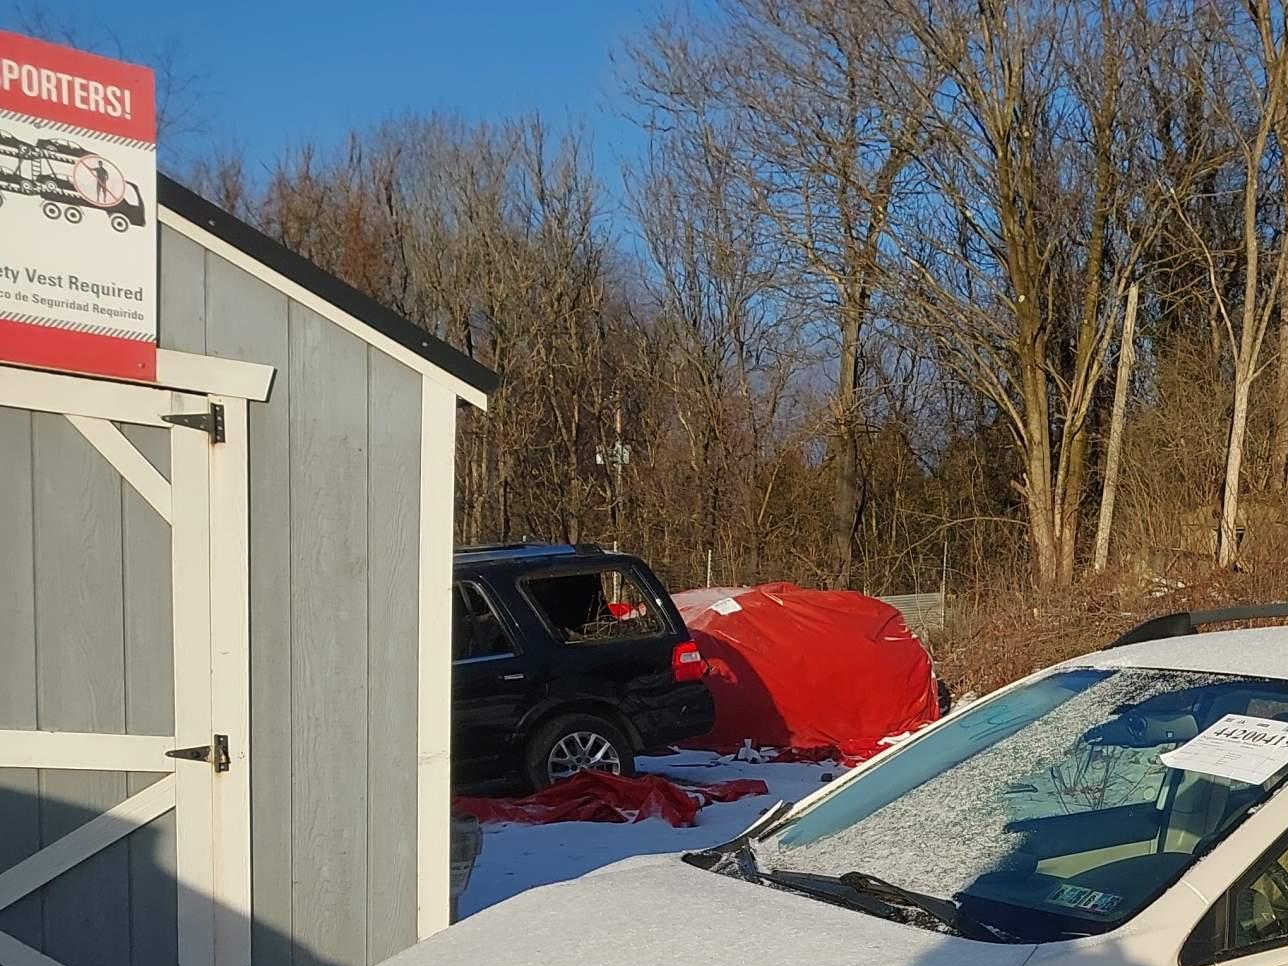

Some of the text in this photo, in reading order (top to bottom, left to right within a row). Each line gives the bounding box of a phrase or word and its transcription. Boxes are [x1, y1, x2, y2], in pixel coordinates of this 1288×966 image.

[0, 58, 132, 120] PORTERS!
[25, 267, 63, 289] Vest
[68, 275, 143, 301] Required
[15, 290, 28, 302] de
[32, 293, 89, 313] Seguridad
[92, 303, 144, 321] Requirido
